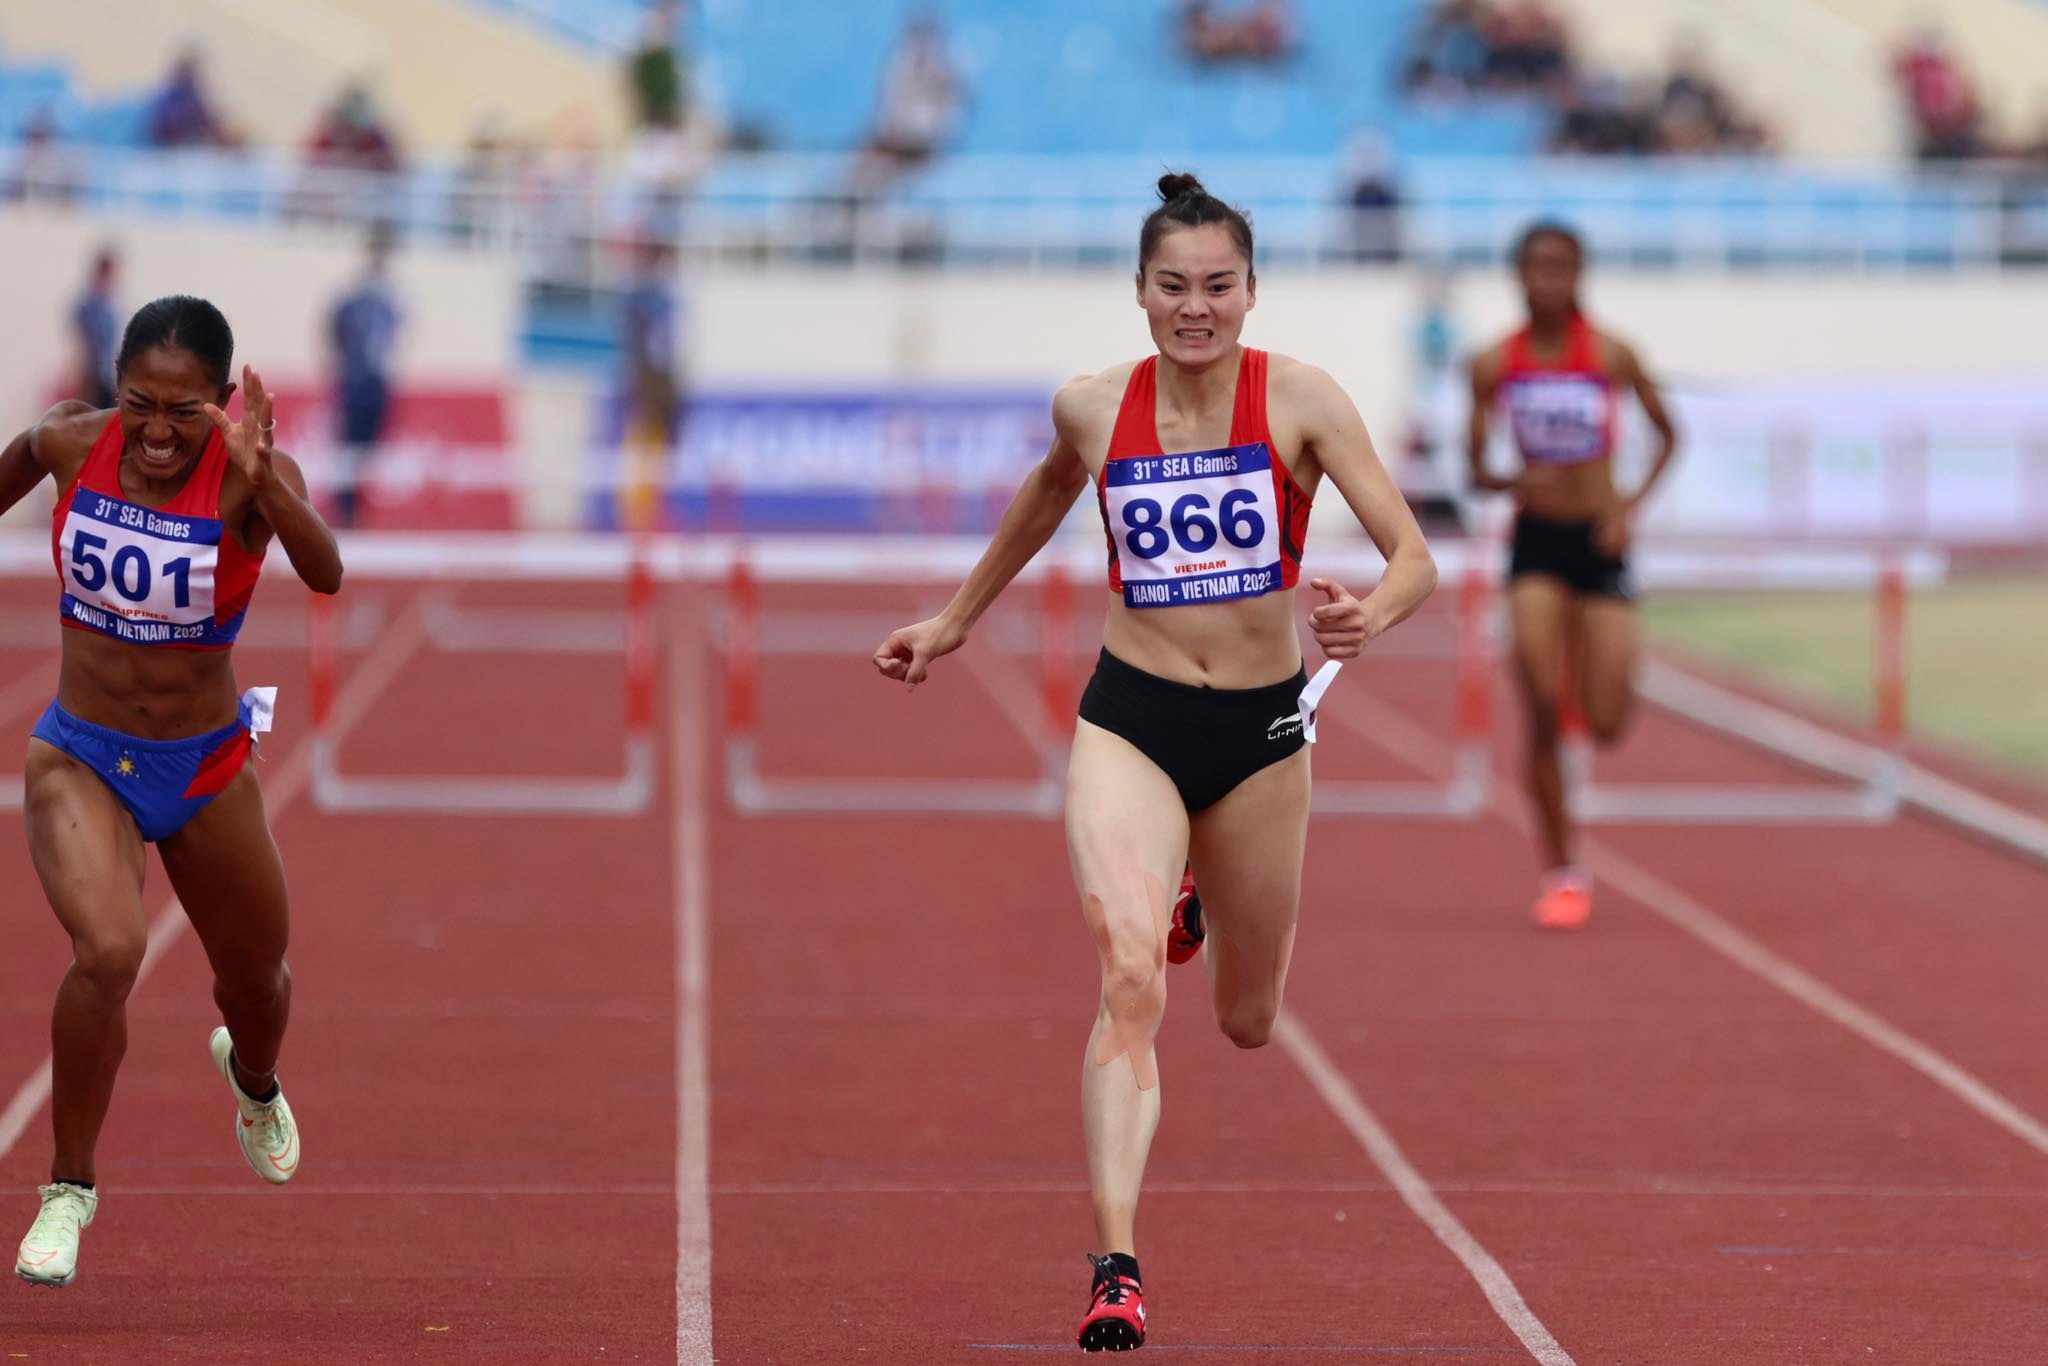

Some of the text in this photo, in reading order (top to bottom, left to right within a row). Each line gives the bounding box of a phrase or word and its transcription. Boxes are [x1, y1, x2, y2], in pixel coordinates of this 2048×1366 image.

[1162, 458, 1191, 478] SEA
[1194, 455, 1238, 473] Games
[119, 505, 143, 529] SEA
[146, 512, 190, 538] Games
[1122, 488, 1265, 560] 866
[71, 529, 191, 608] 501
[1174, 560, 1227, 574] VIETNAM
[1132, 584, 1170, 603] HANOI
[1181, 575, 1240, 600] VIETNAM
[1243, 571, 1272, 592] 2022
[73, 601, 107, 629] HANOI
[116, 618, 170, 641] VIETNAM
[173, 624, 204, 639] 2022
[100, 601, 169, 620] PHILIPPINES
